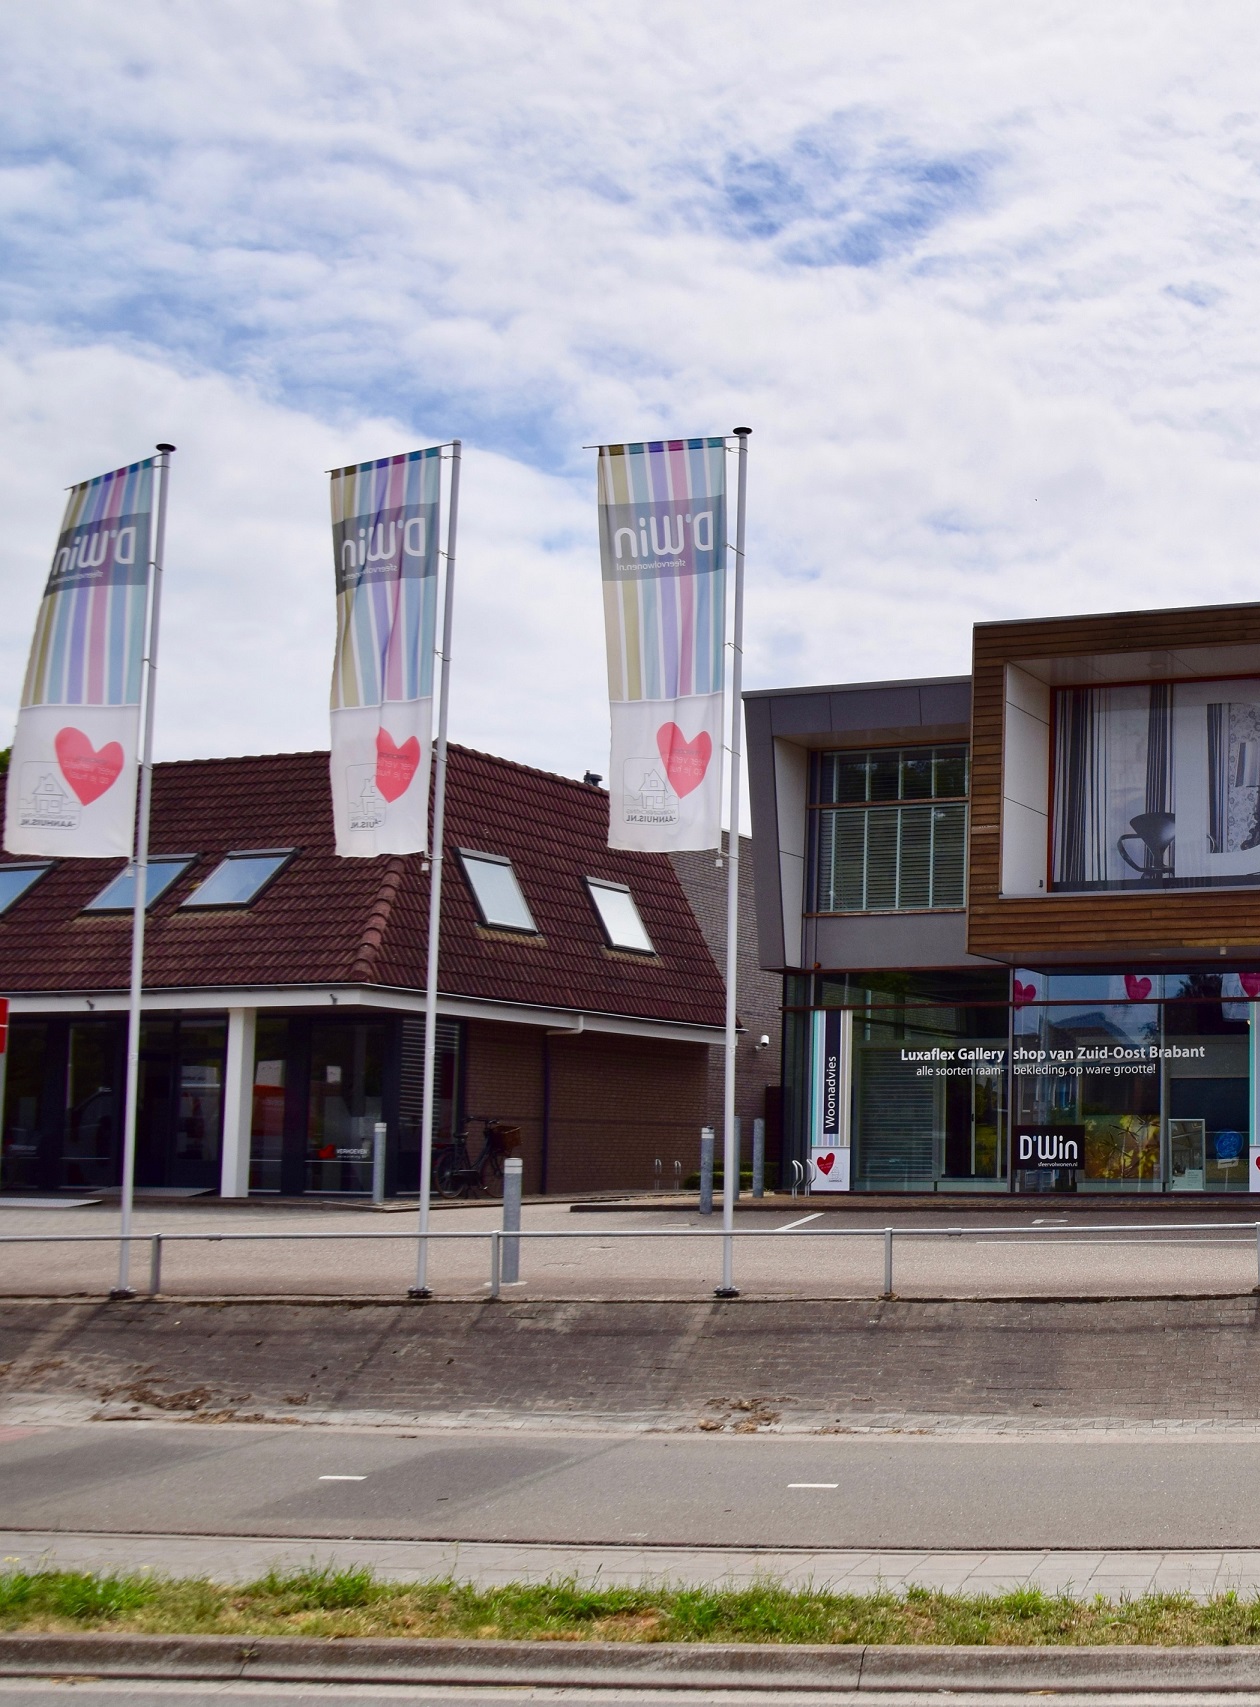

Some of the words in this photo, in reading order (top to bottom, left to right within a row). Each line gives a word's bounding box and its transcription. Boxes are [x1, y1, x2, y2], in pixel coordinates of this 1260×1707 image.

[901, 1047, 955, 1061] Luxaflex
[957, 1047, 1005, 1063] Gallery
[1012, 1047, 1046, 1063] shop
[1050, 1050, 1074, 1060] van
[1077, 1046, 1146, 1059] Zuid-Oost
[1149, 1045, 1205, 1058] Brabant
[916, 1065, 933, 1076] alle
[935, 1066, 973, 1076] soorten
[975, 1067, 1005, 1076] raam-
[1069, 1067, 1083, 1077] op
[1086, 1066, 1111, 1075] ware
[1113, 1063, 1156, 1077] grootte!
[825, 1056, 837, 1128] Woonadvies
[1019, 1135, 1078, 1160] D'Win
